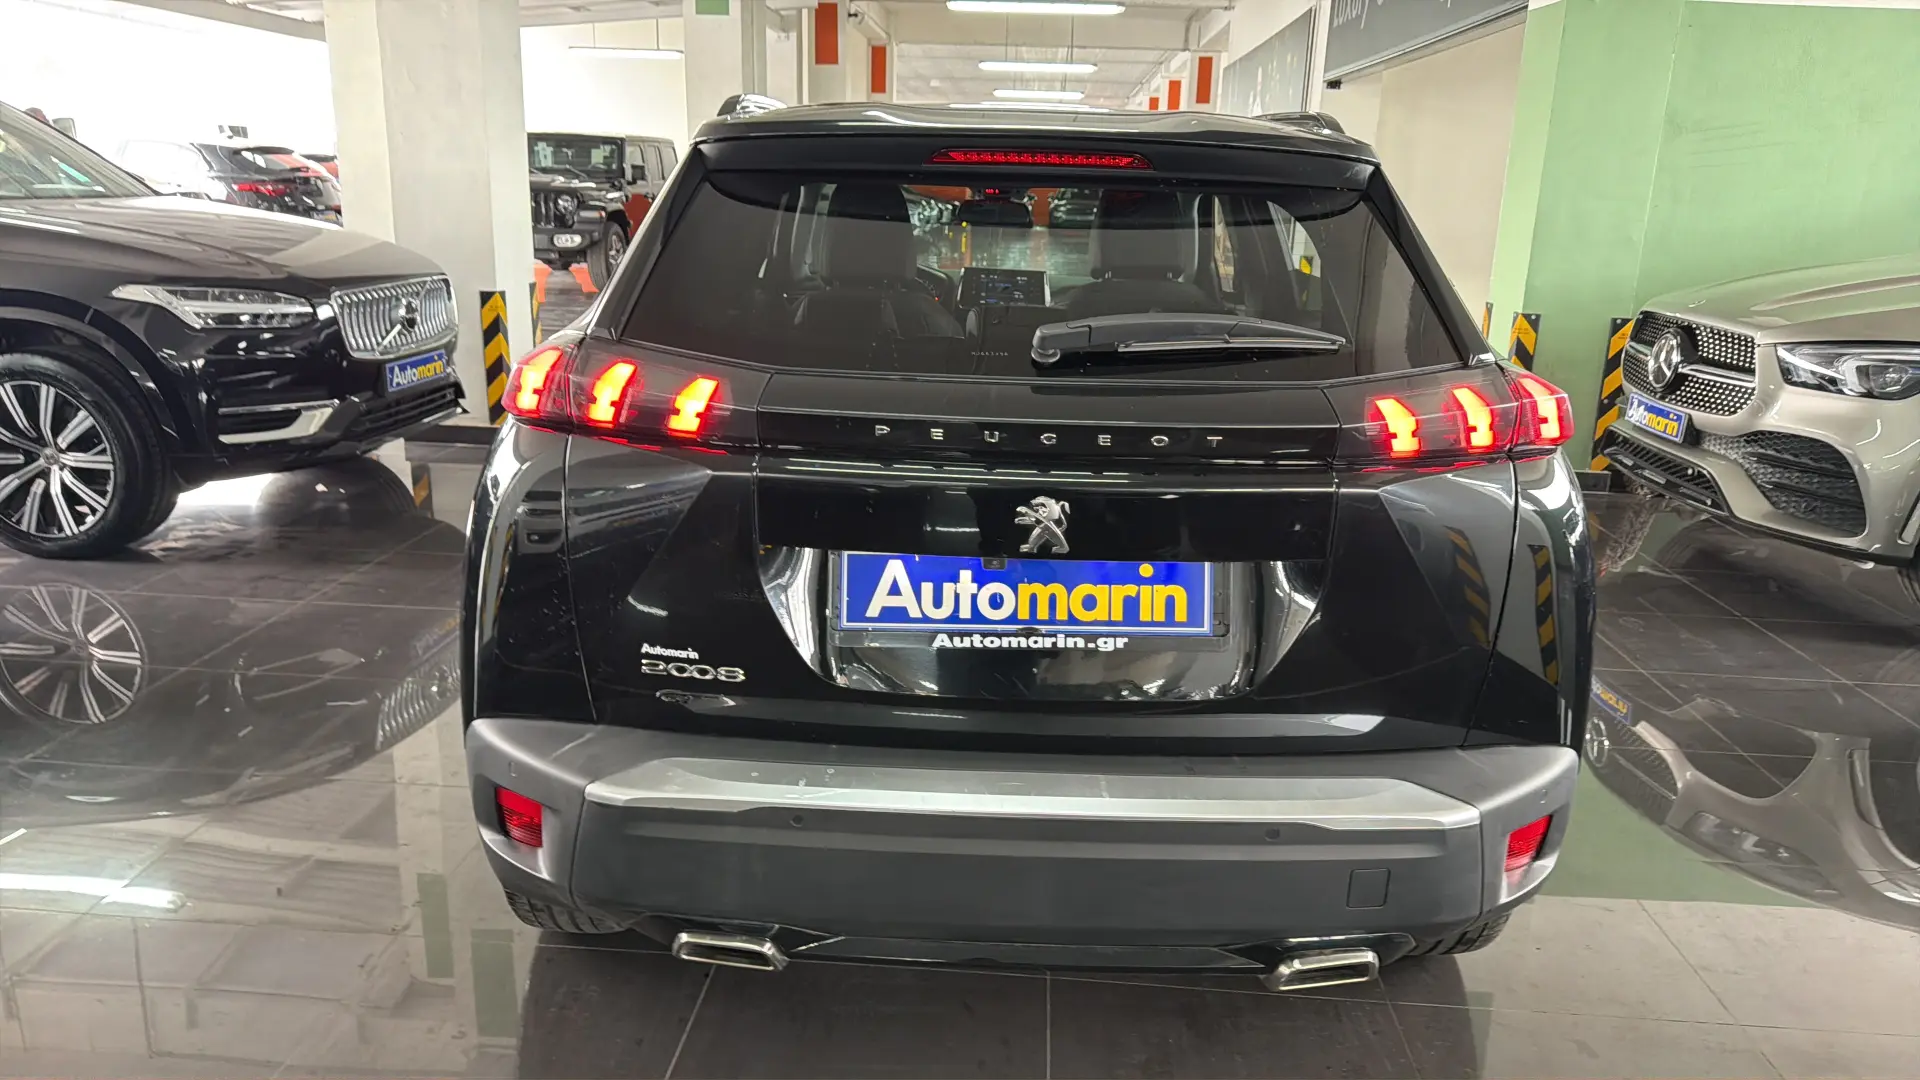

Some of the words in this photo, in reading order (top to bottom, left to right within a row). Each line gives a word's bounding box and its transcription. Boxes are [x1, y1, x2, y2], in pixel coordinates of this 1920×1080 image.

[392, 355, 444, 387] Automarin
[874, 424, 1224, 449] PEUGEOT
[864, 559, 1188, 623] Automarin
[641, 642, 700, 660] Automarin
[931, 632, 1129, 652] Automarin.gr
[641, 659, 746, 682] 2008
